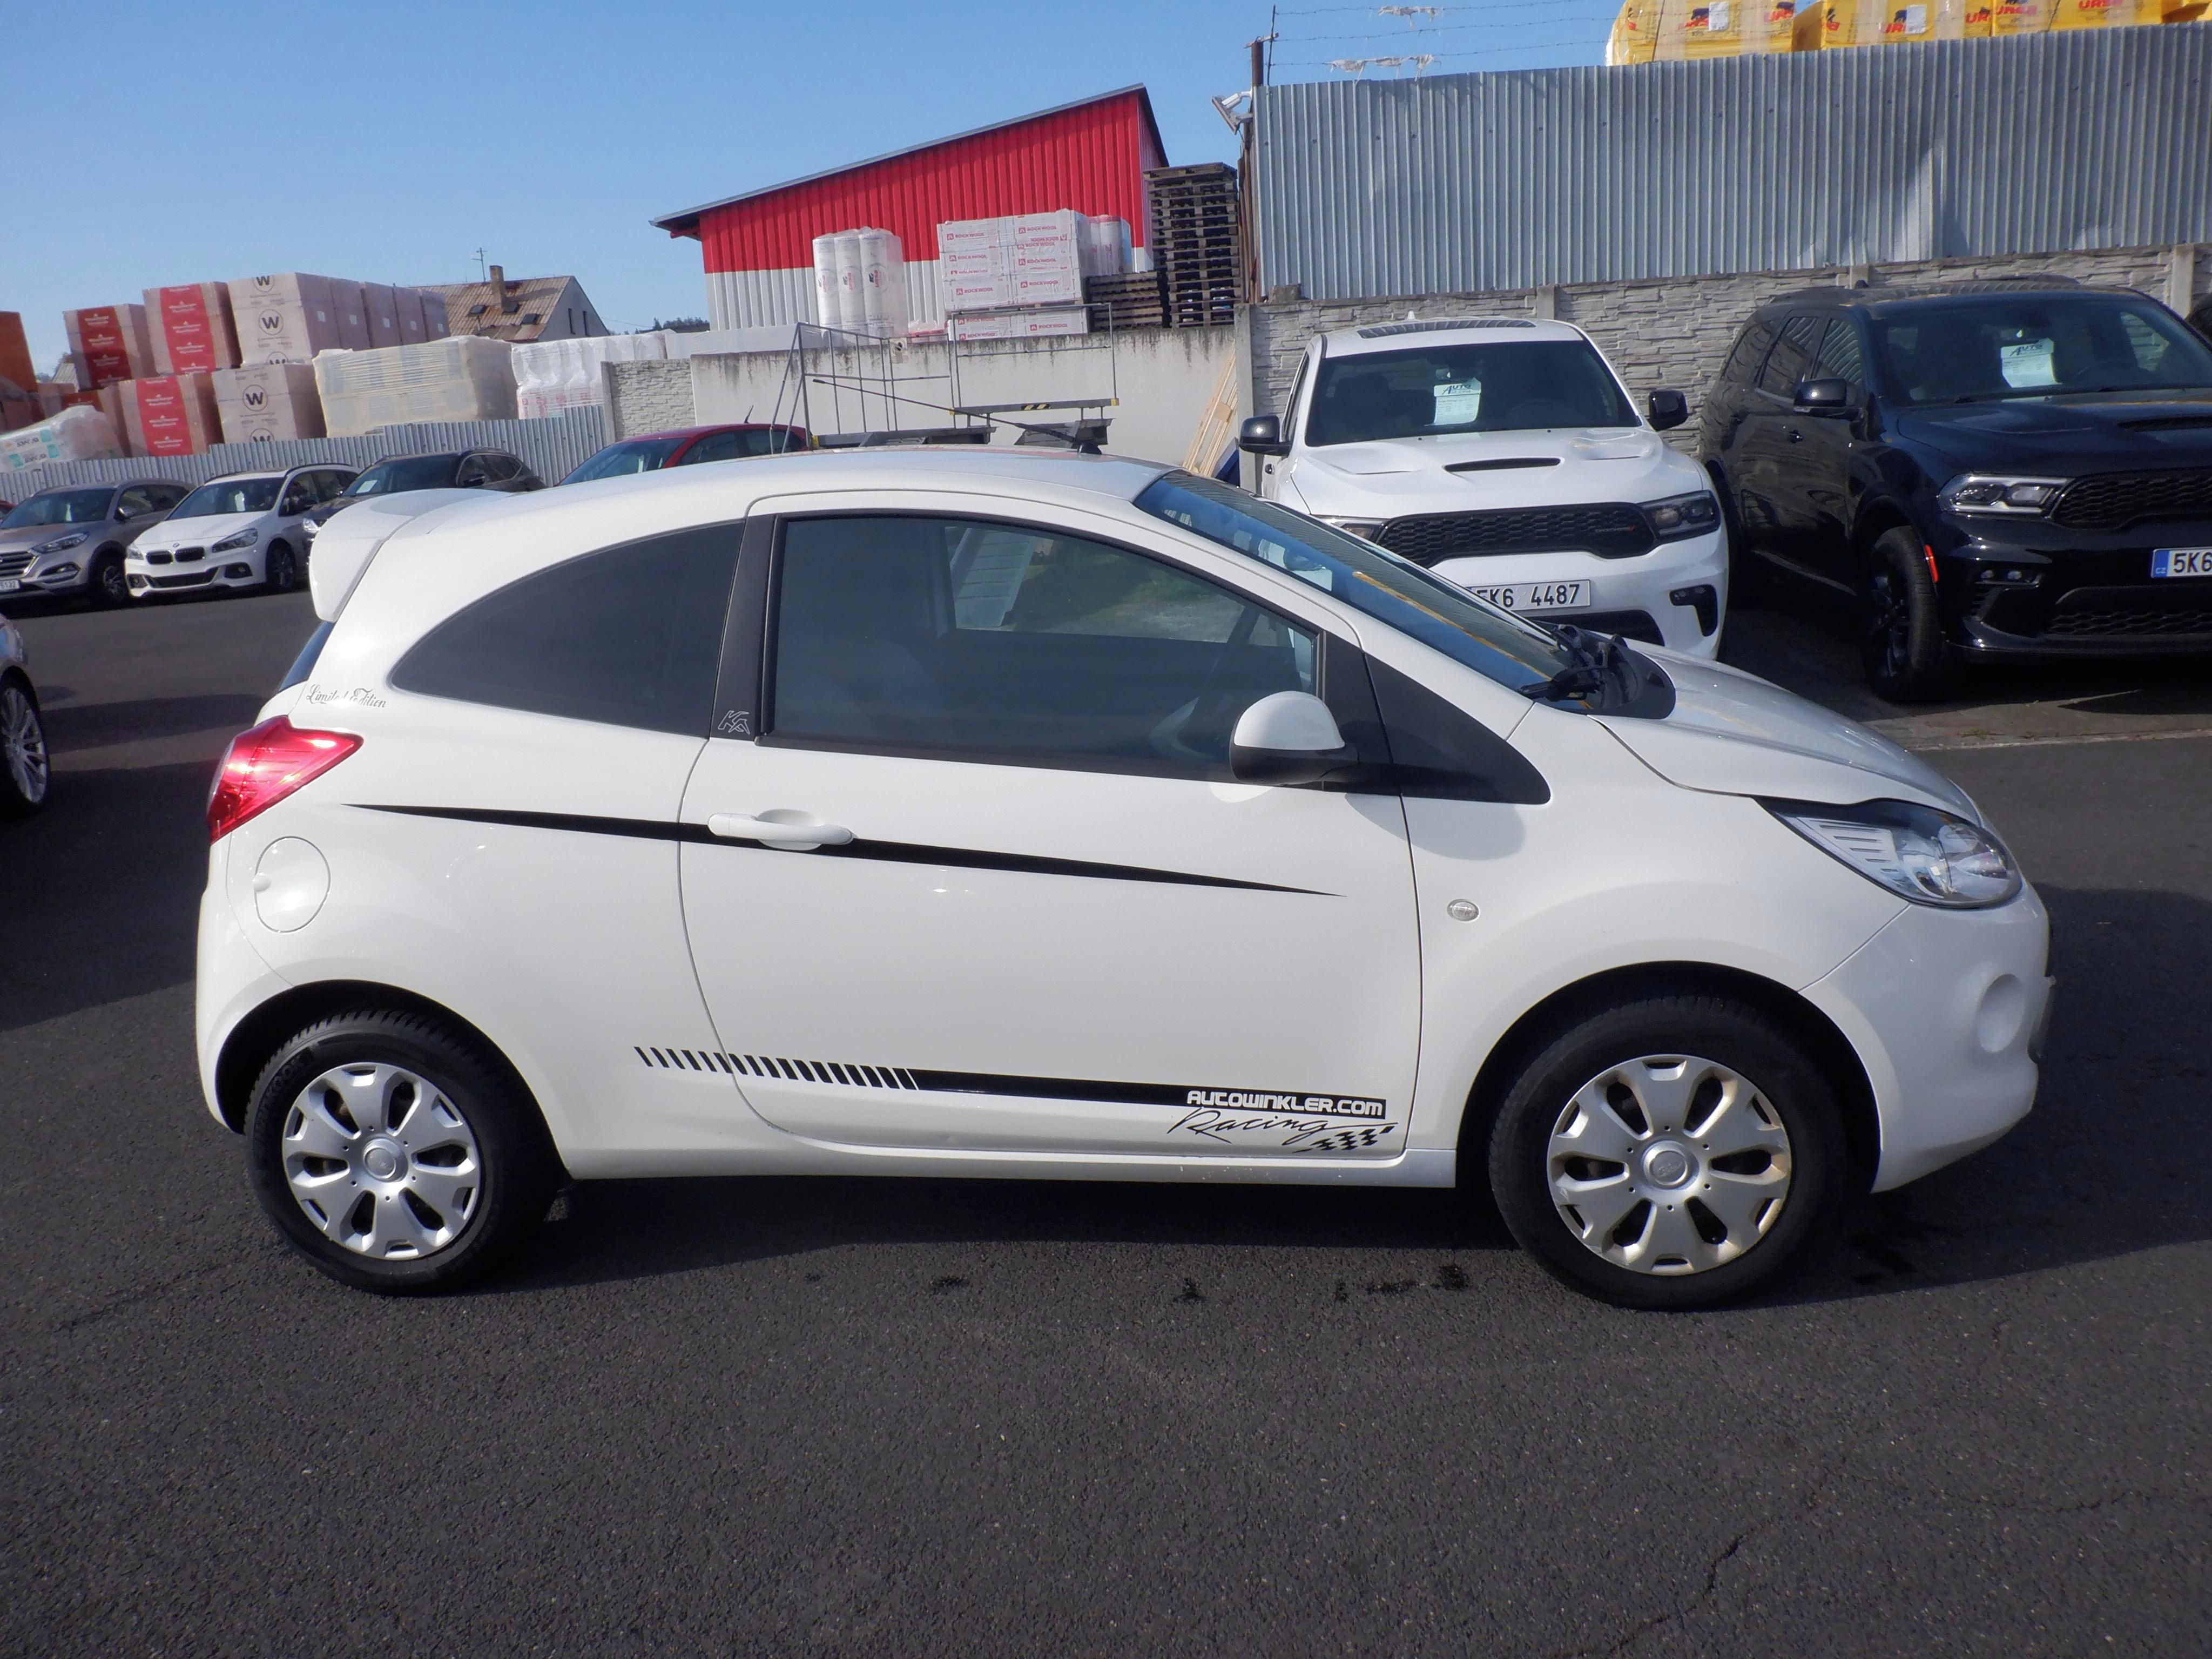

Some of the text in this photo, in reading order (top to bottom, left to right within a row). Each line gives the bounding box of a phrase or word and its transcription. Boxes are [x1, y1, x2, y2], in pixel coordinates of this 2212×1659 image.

[261, 316, 279, 329] W
[245, 392, 264, 406] W
[2173, 551, 2212, 573] 5K6
[1476, 584, 1580, 608] K6 4487
[1186, 1090, 1384, 1116] AUTOWINKLER.COM
[1166, 1107, 1399, 1146] Racing
